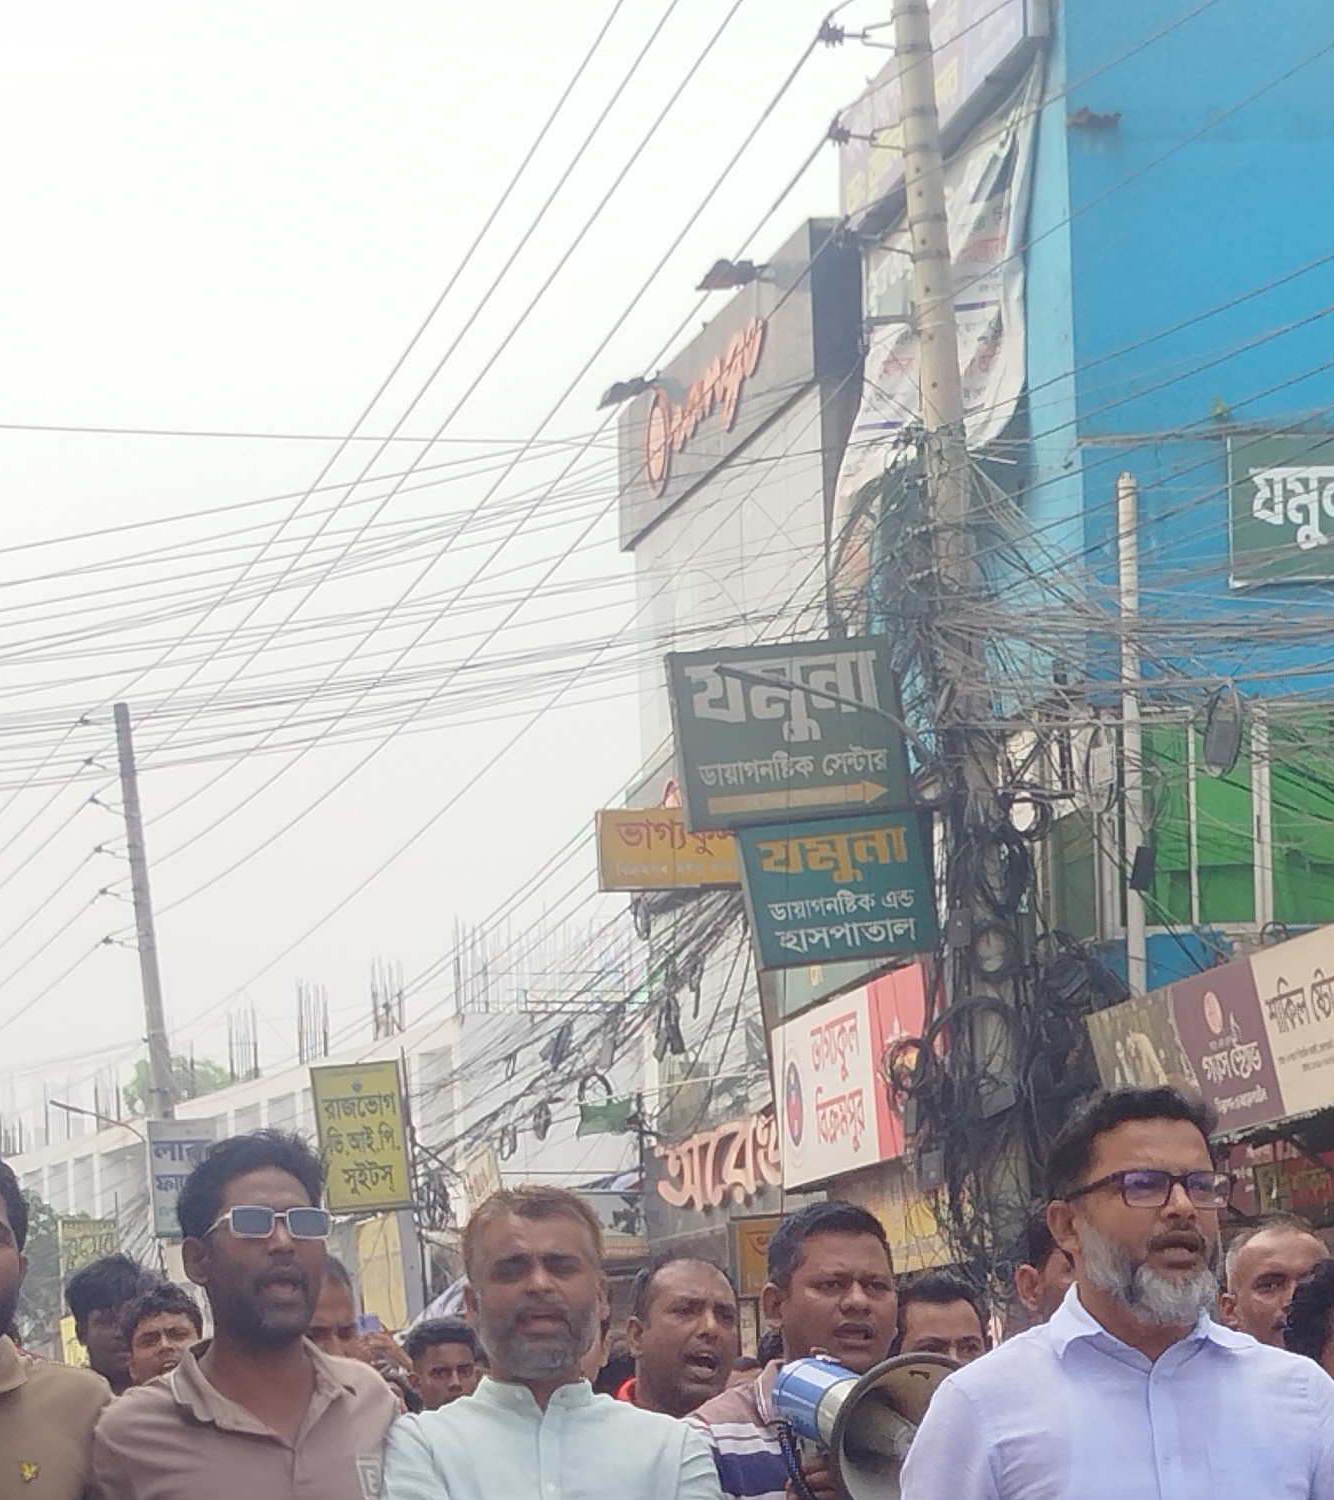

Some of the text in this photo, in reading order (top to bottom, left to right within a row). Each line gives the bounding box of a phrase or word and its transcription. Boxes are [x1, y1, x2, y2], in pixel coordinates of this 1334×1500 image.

[684, 650, 878, 741] যমুনা
[822, 748, 888, 777] সেন্টার
[755, 826, 906, 883] যমুনা
[775, 916, 916, 954] হাসপাতাল
[323, 1091, 397, 1121] রাজভোগ
